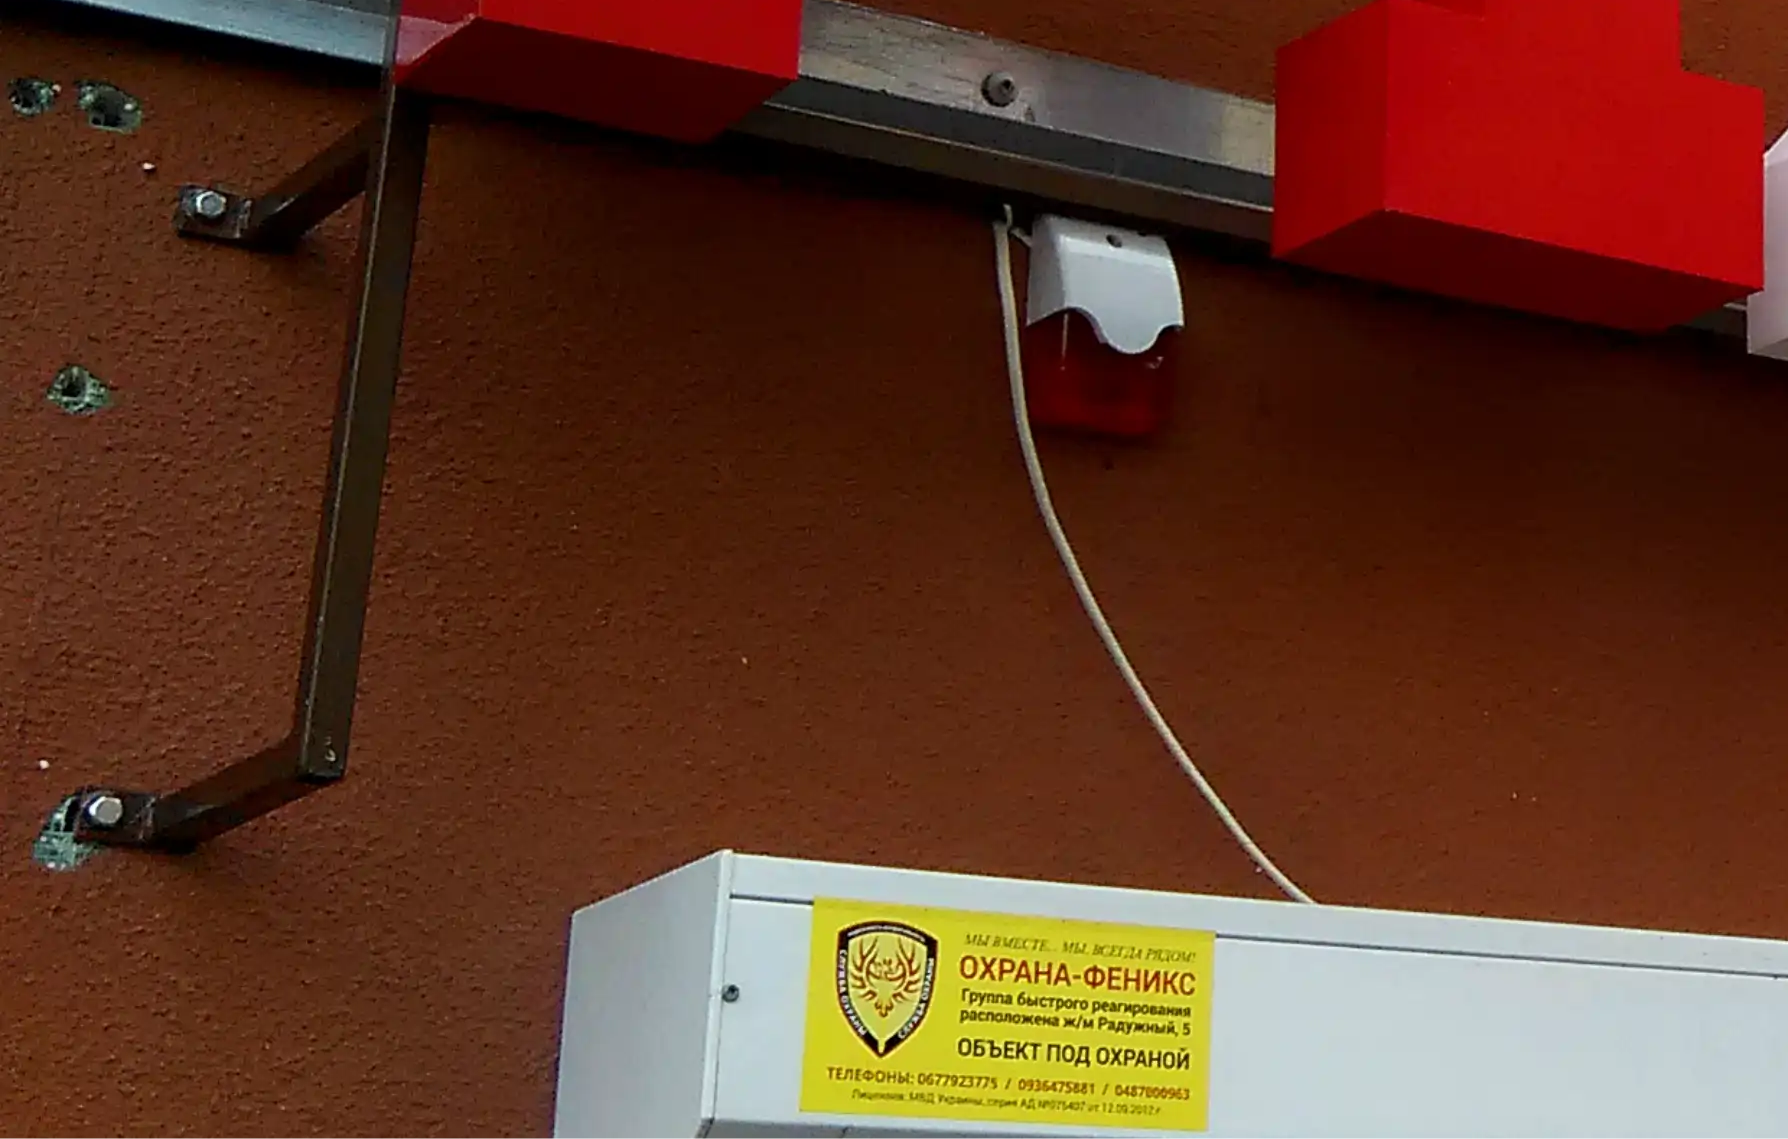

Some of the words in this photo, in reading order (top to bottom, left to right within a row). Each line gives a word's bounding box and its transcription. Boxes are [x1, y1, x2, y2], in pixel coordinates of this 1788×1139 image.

[965, 933, 988, 947] МЫ
[1092, 946, 1142, 961] ВСЕГДА
[959, 954, 1197, 997] ОХРАНА-ФЕНИКС
[961, 987, 1013, 1007] Группа
[1016, 991, 1089, 1014] быстрого
[1091, 1000, 1192, 1018] реагирования
[959, 1008, 1060, 1028] расположена
[1063, 1014, 1095, 1030] ж/м
[1098, 1017, 1179, 1036] Радужный,
[1182, 1022, 1192, 1036] 5
[957, 1037, 1042, 1061] ОБЪЕКТ
[1046, 1044, 1091, 1068] ПОД
[1096, 1046, 1191, 1071] ОХРАНОЙ
[827, 1066, 914, 1086] ТЕЛЕФОНЫ:
[918, 1072, 998, 1089] 0677923775
[1017, 1077, 1095, 1095] 0936475881
